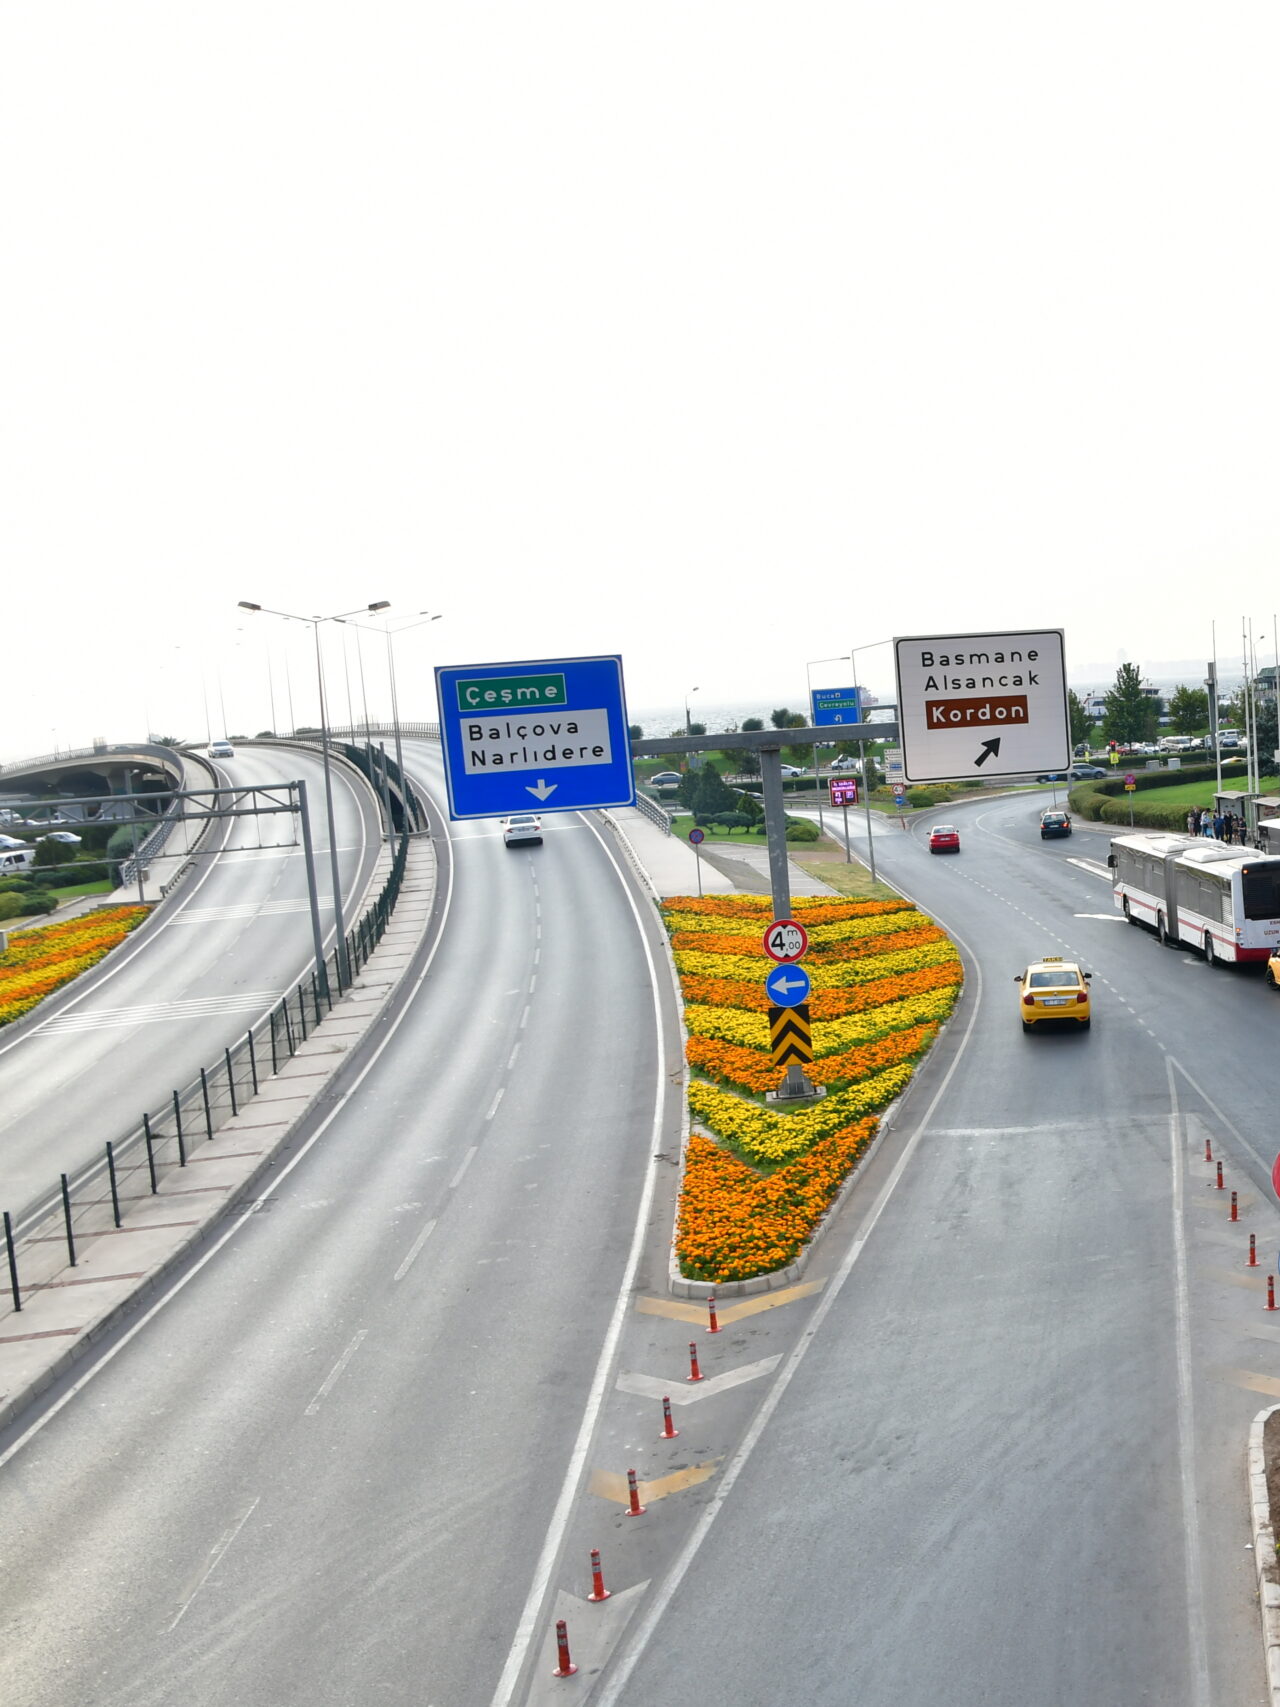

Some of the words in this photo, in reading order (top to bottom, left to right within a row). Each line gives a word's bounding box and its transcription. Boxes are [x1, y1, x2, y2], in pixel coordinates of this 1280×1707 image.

[921, 649, 1039, 667] Basmane
[924, 670, 1040, 692] Alsancak
[465, 685, 558, 706] Çeşme
[932, 703, 1024, 723] Kordon
[468, 721, 579, 741] Balçova
[471, 744, 604, 767] Narlıdere
